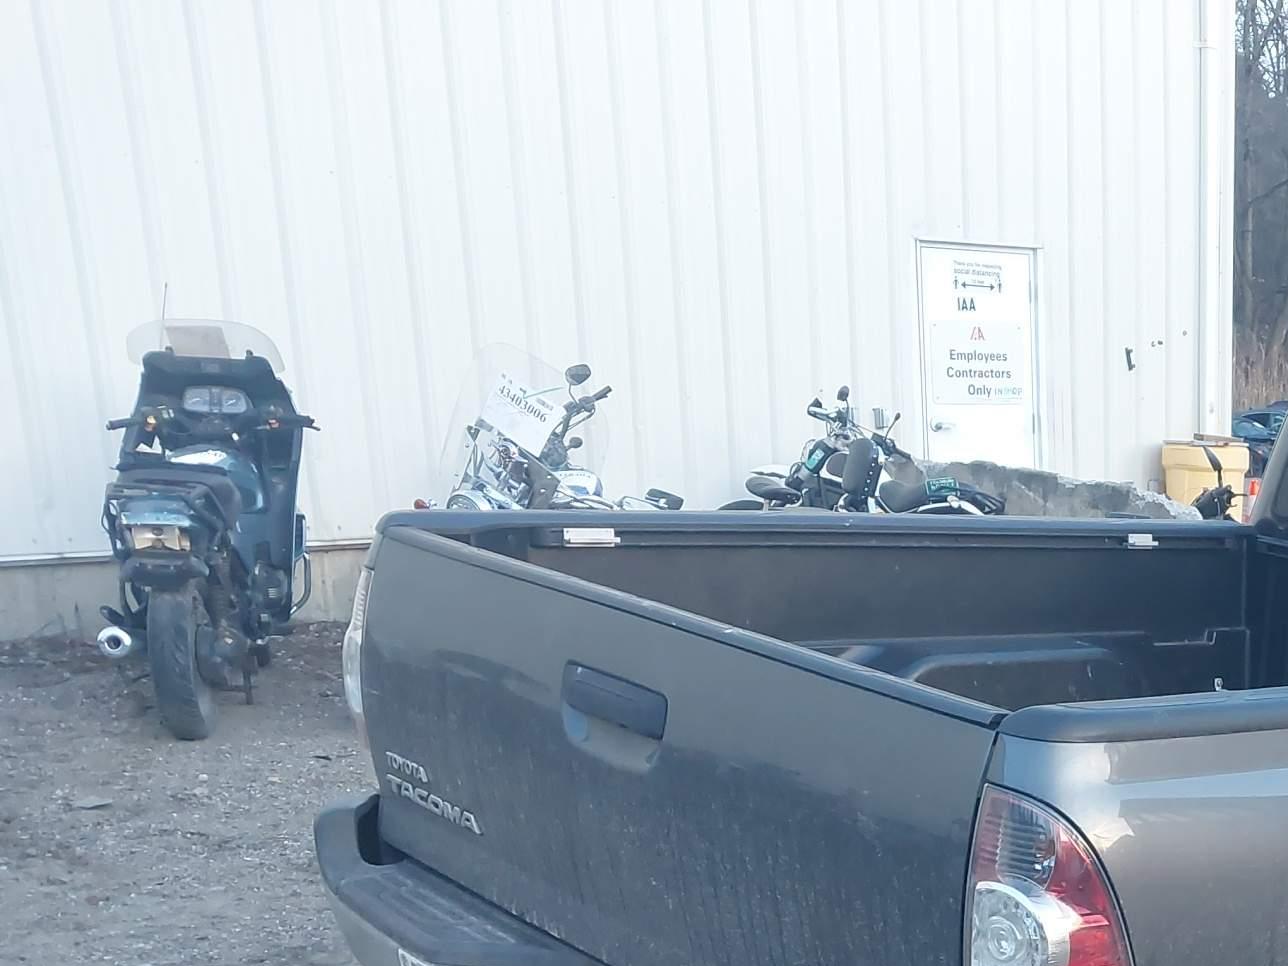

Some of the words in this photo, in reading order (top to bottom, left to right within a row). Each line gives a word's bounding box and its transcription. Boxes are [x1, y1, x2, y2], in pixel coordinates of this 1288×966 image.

[957, 297, 976, 312] IAA
[949, 348, 1008, 363] Employees
[946, 366, 1012, 379] Contractors
[967, 384, 992, 398] Only
[499, 384, 547, 423] 43403006
[385, 751, 429, 783] TOYOTA
[386, 773, 483, 835] TACOMA
